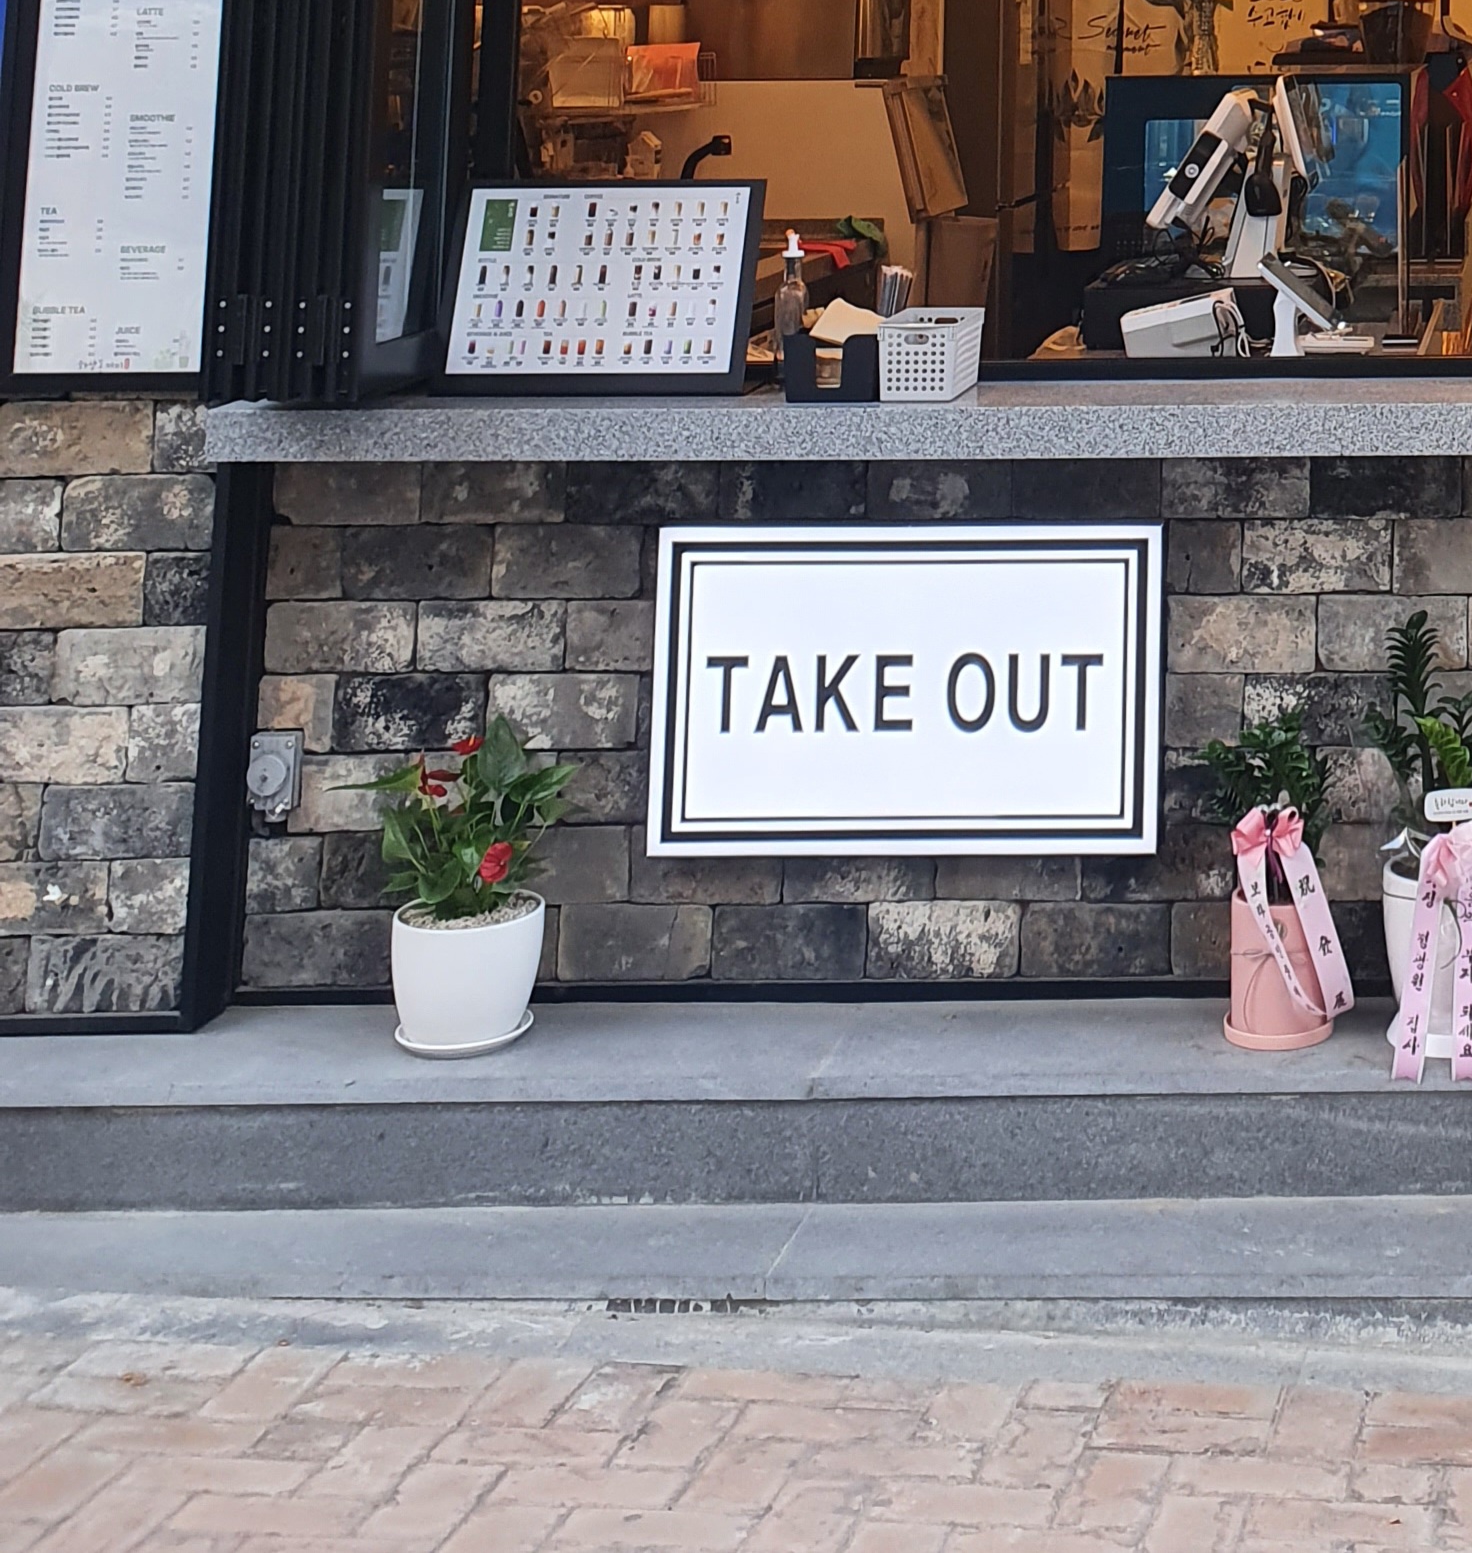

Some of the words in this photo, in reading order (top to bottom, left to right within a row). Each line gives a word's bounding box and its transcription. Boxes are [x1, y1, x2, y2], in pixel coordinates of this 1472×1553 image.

[136, 7, 164, 16] LATTE
[49, 84, 72, 92] COLD
[74, 84, 99, 92] BREW
[130, 114, 175, 122] SMOOTHIE
[40, 207, 57, 215] TEA
[120, 245, 166, 254] BEVERAGE
[68, 306, 85, 314] TEA
[115, 326, 141, 335] JUICE
[706, 654, 915, 734] TAKE
[946, 652, 1104, 734] OUT
